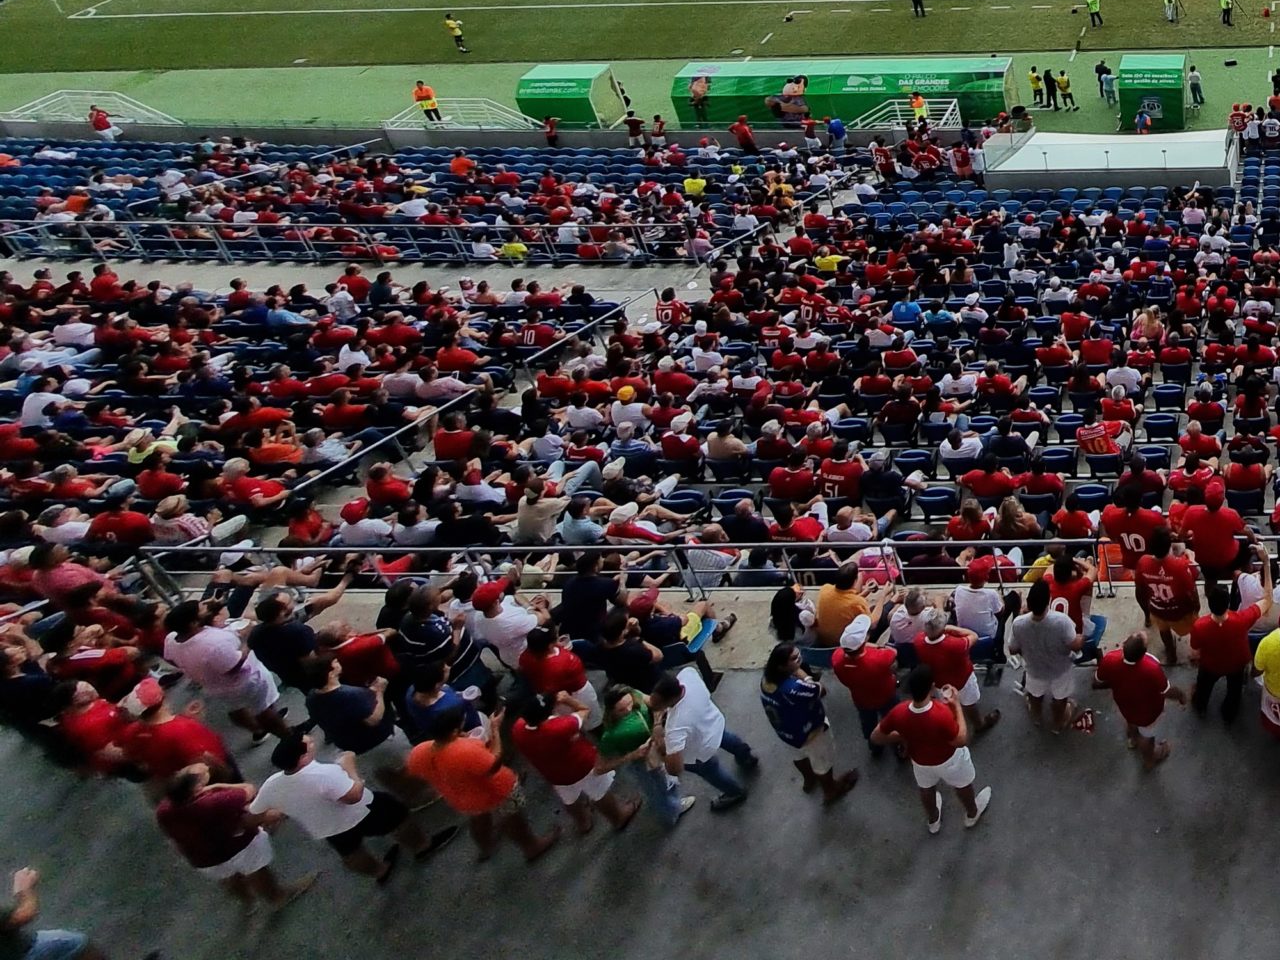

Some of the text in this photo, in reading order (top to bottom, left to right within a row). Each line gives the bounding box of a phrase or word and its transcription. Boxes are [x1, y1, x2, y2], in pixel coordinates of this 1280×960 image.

[658, 308, 672, 321] 10
[801, 304, 812, 318] 10
[524, 330, 535, 344] 10
[1088, 438, 1107, 453] 10
[825, 484, 839, 497] 51
[1120, 533, 1145, 552] 10
[1150, 584, 1174, 600] 10
